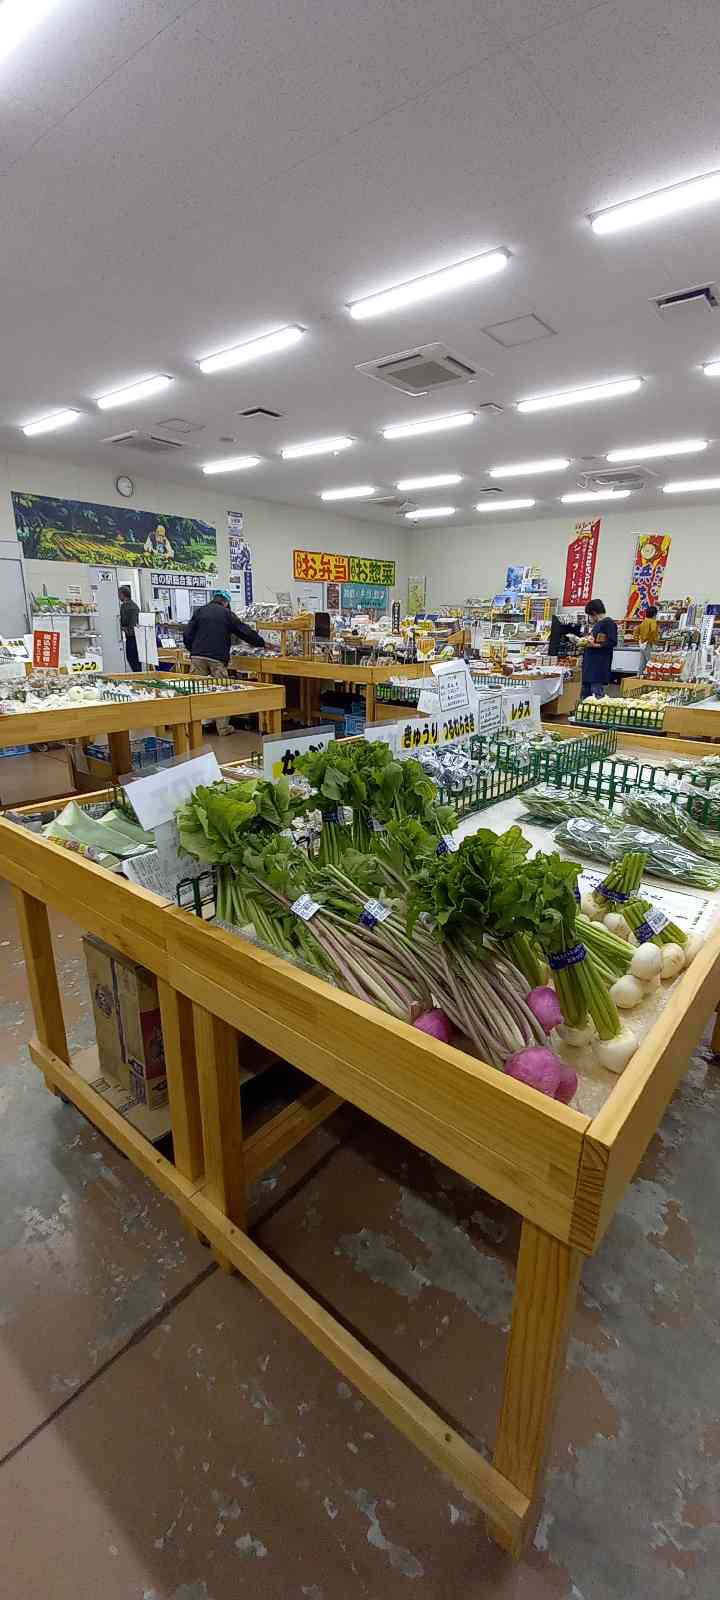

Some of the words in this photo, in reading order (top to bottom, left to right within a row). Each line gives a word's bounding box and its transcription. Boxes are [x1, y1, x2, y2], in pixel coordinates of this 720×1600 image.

[302, 554, 347, 580] お弁当
[72, 661, 97, 672] ニンニク
[511, 700, 531, 721] レタス
[402, 722, 439, 748] きゅうり
[443, 713, 475, 740] つるむらさき
